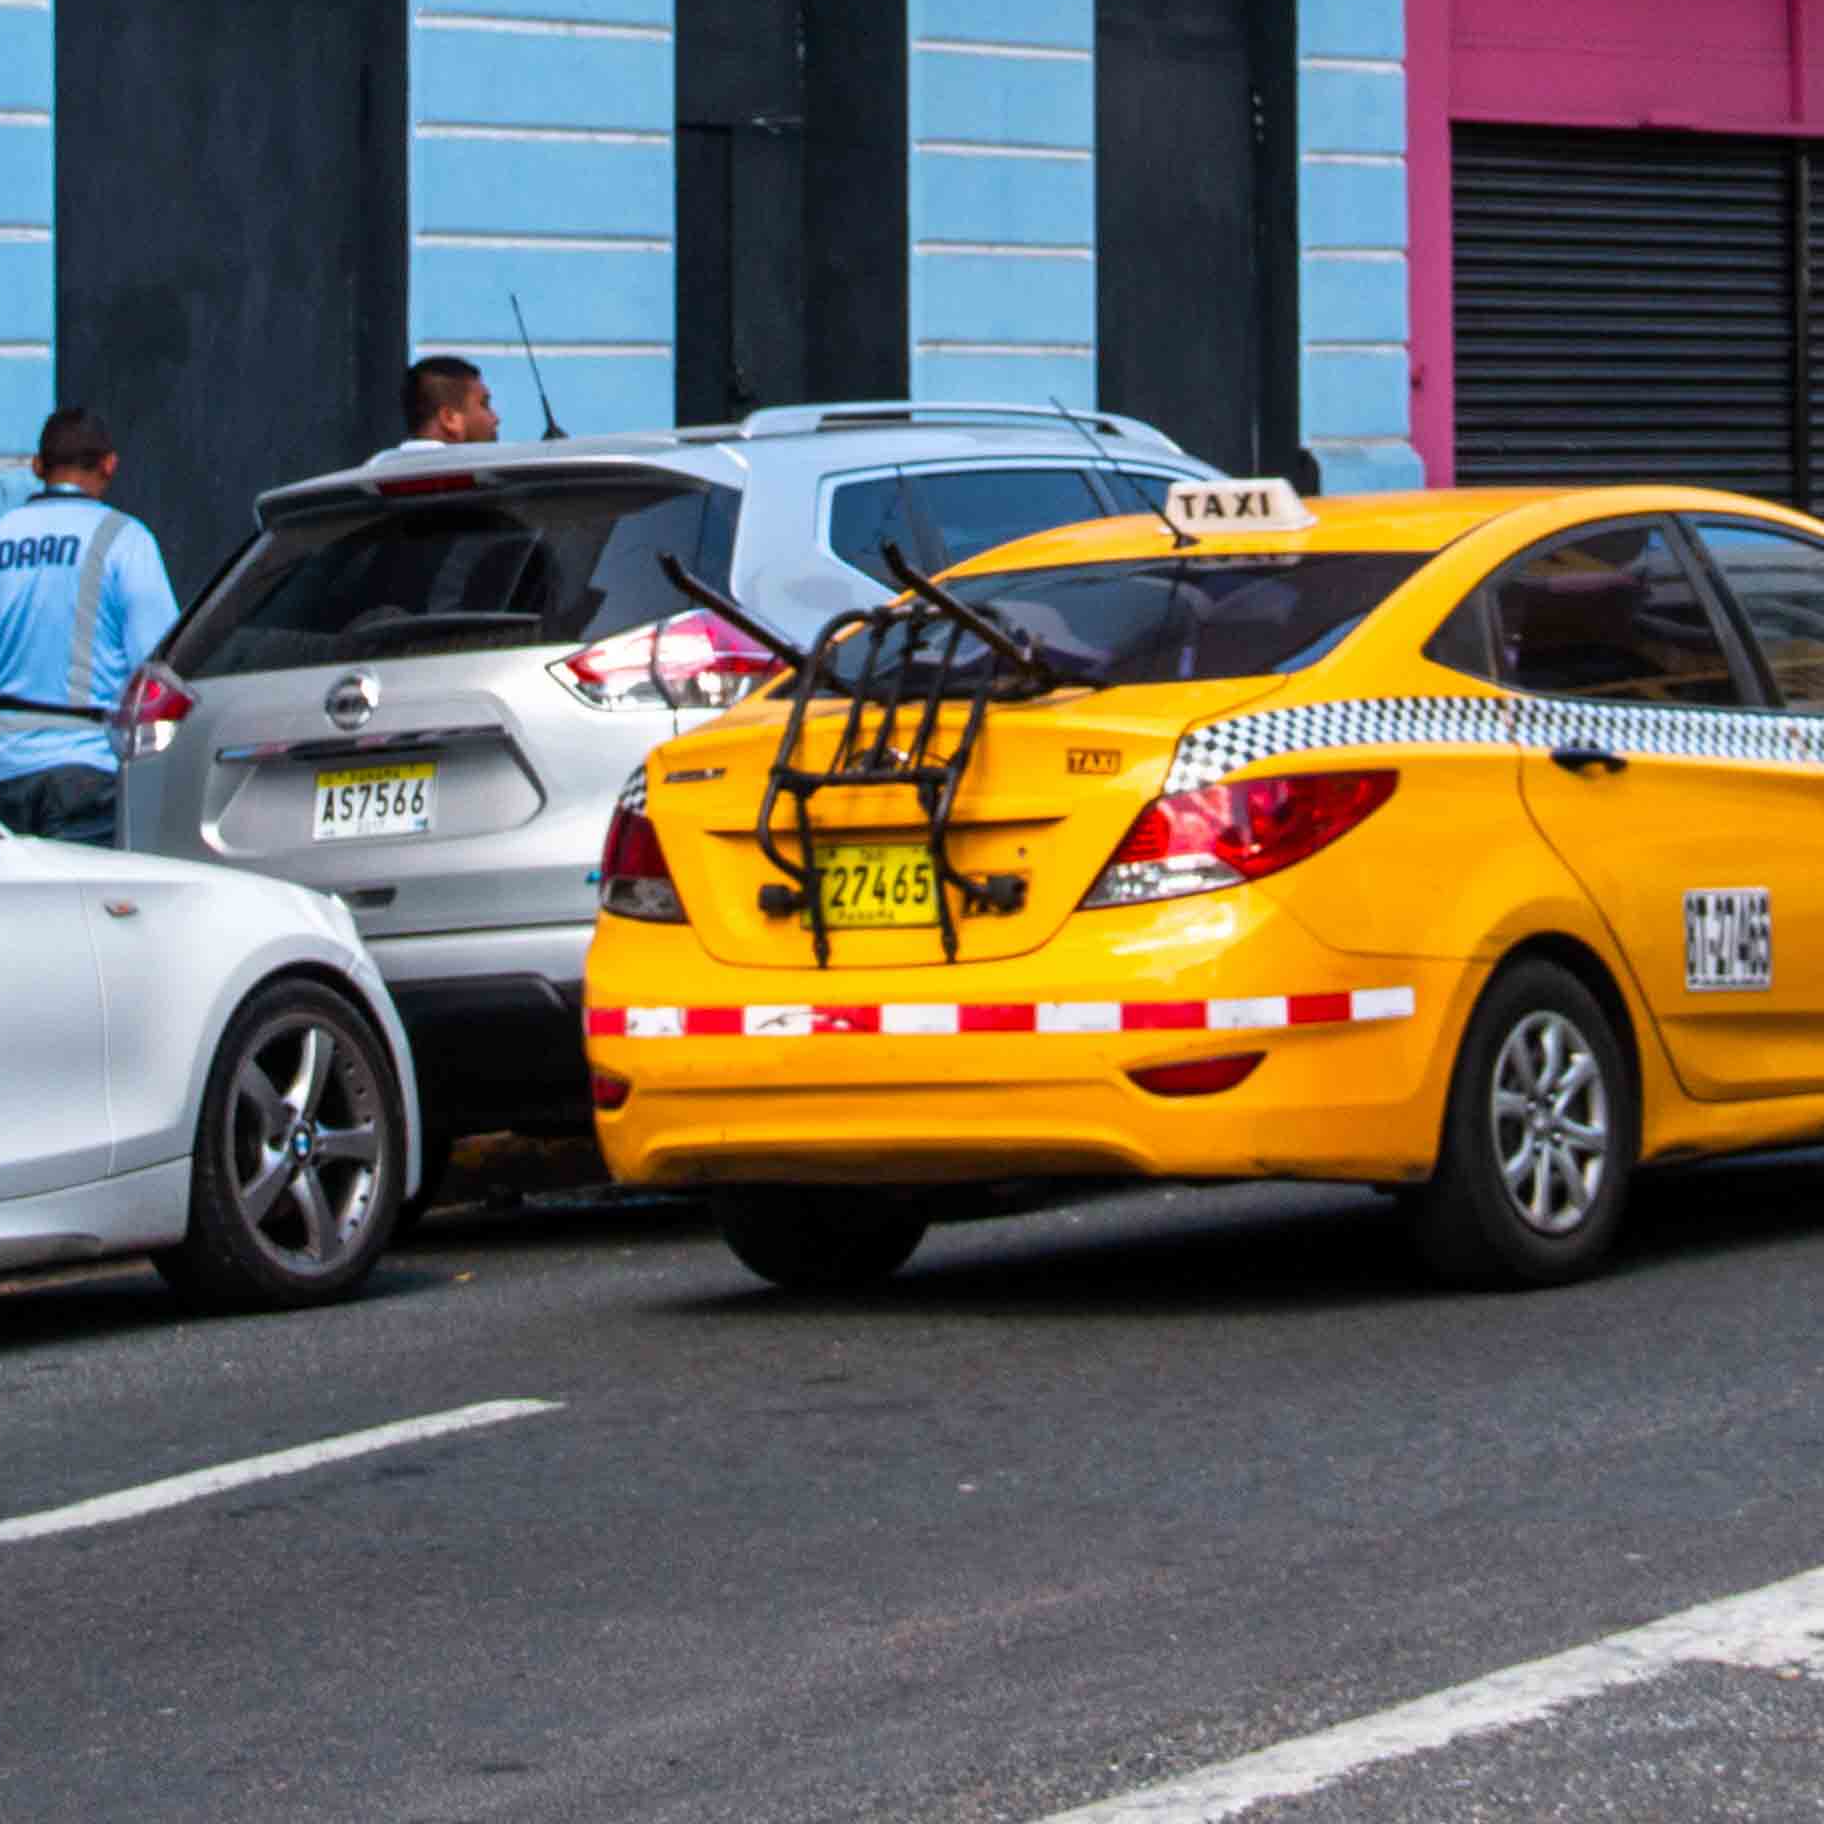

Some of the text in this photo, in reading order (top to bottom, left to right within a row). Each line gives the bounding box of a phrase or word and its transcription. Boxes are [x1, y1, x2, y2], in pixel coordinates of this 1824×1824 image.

[1179, 492, 1271, 518] TAXI
[1067, 749, 1121, 773] TAXI
[322, 778, 425, 823] AS7566
